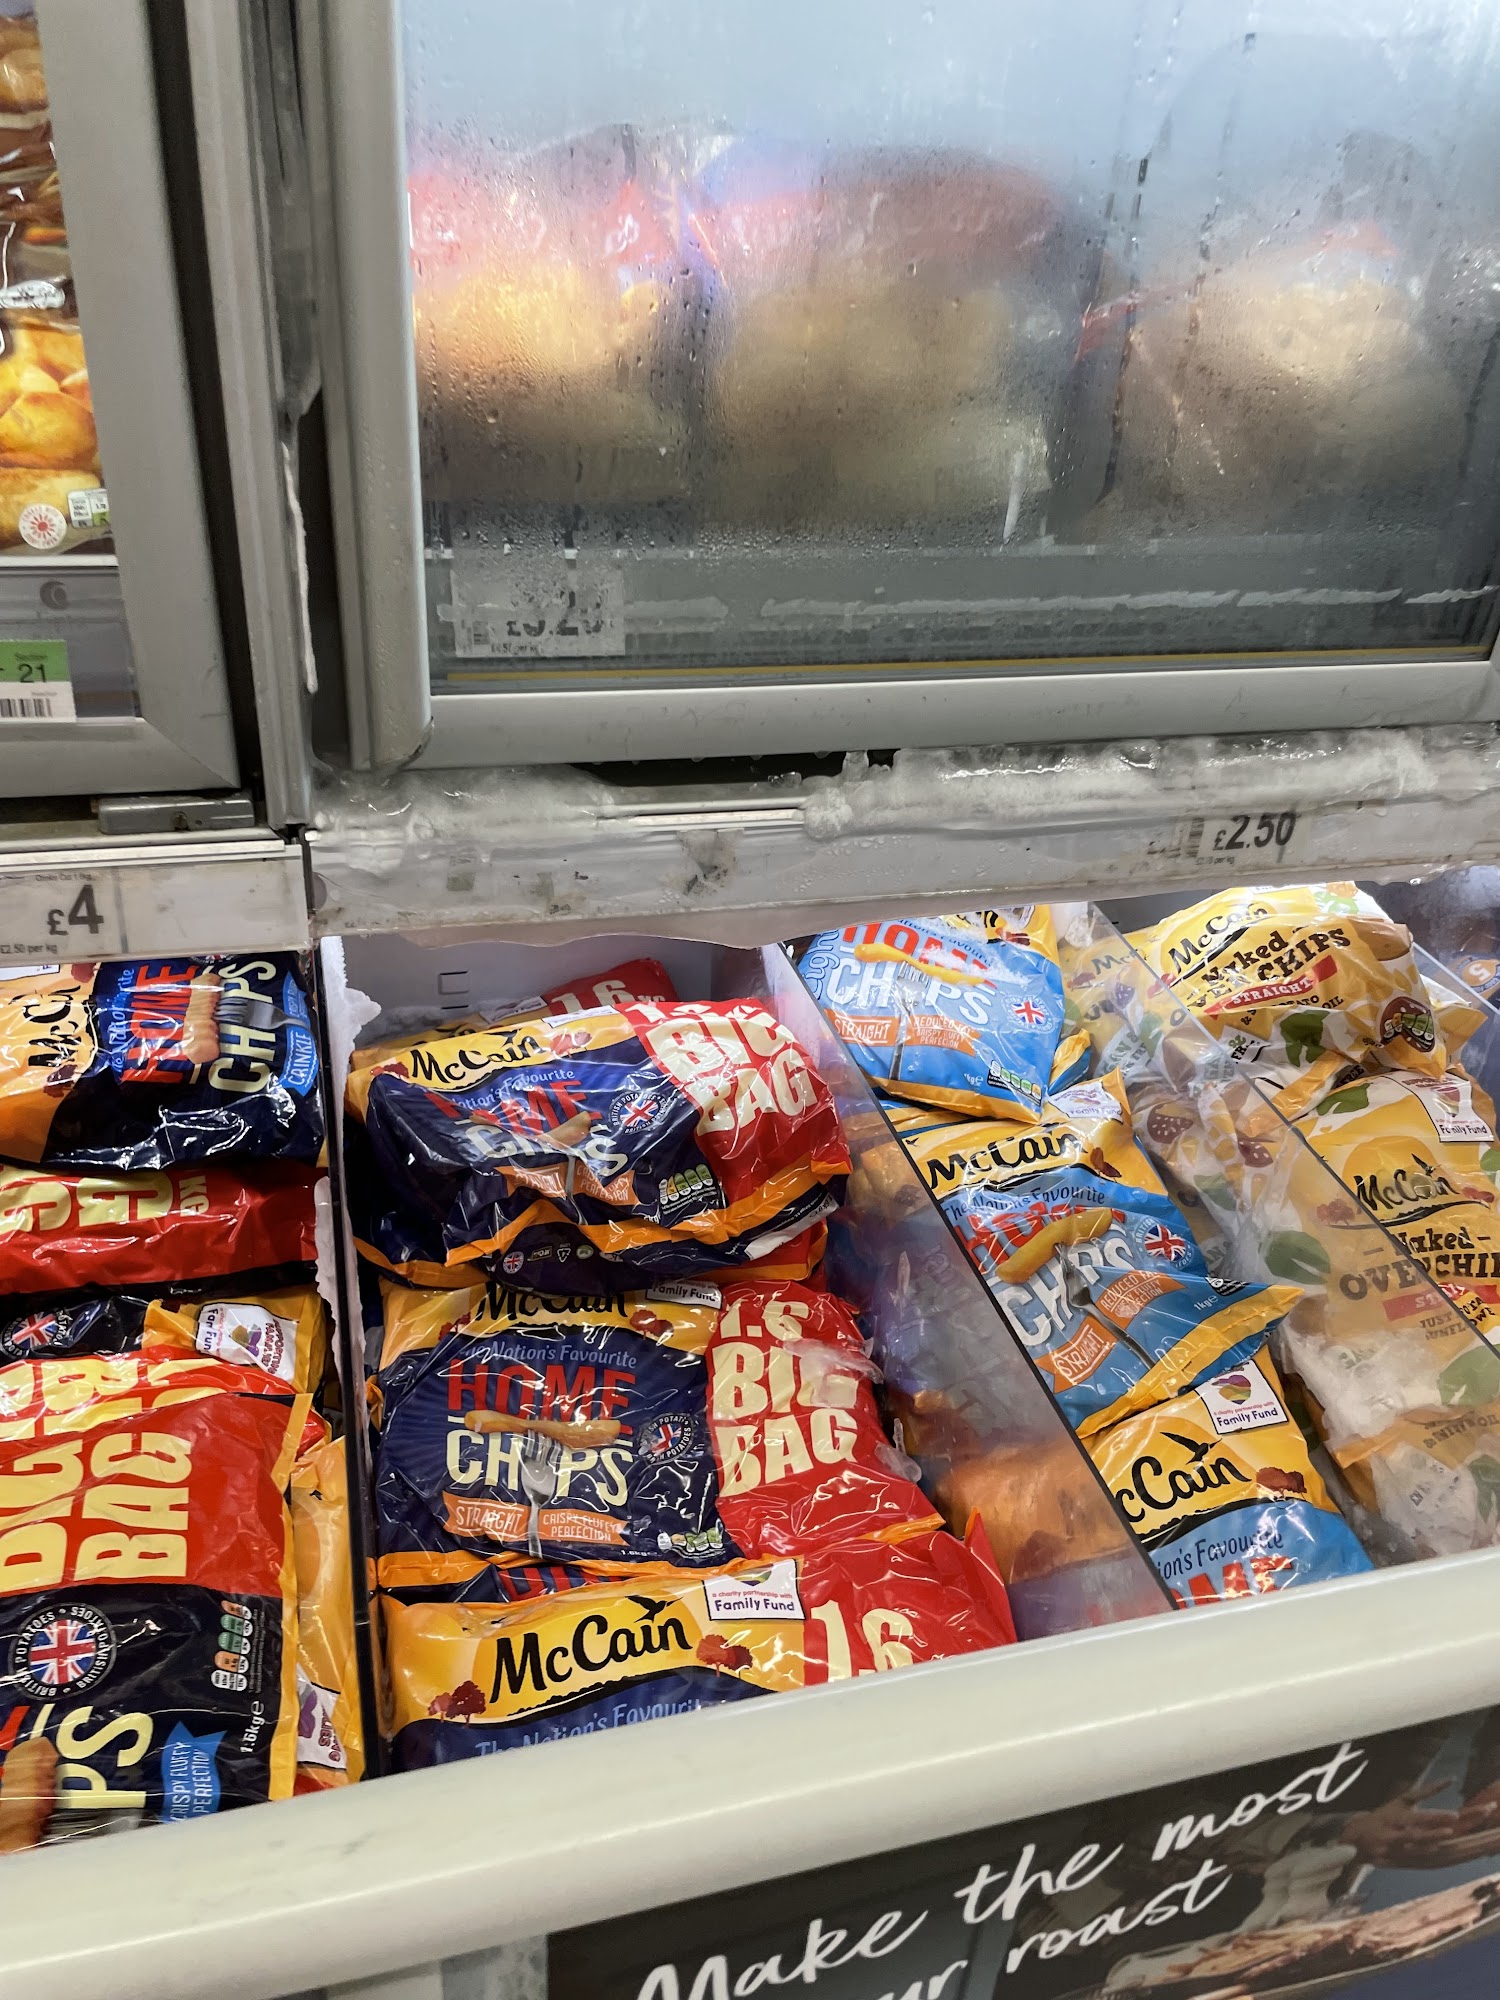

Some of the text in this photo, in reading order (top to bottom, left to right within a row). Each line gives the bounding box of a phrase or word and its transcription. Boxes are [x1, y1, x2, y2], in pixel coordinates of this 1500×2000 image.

[18, 664, 46, 683] 21
[1213, 811, 1297, 851] £2.50
[46, 884, 104, 935] £4
[1257, 927, 1351, 982] CHIPS
[1231, 976, 1313, 1004] STRAIGHT
[834, 1019, 891, 1041] STRAIGHT
[288, 1031, 312, 1086] CRINKLE
[411, 1034, 546, 1084] McCain
[685, 1048, 818, 1137] BAG
[1031, 1186, 1105, 1205] Favourite
[1100, 1274, 1139, 1312] REDUCED
[489, 1341, 557, 1362] Nation's
[559, 1344, 637, 1369] Favourite
[447, 1357, 637, 1435] HOME
[1216, 1407, 1279, 1427] Family Fund
[666, 1427, 692, 1458] POTATOES
[714, 1407, 860, 1497] BAG
[73, 1432, 193, 1581] BAG
[1114, 1455, 1252, 1523] cCain
[455, 1506, 523, 1532] STRAIGHT
[543, 1513, 580, 1527] CRISPY
[714, 1597, 795, 1612] Family Fund
[718, 1590, 742, 1599] charity
[743, 1590, 779, 1600] partnership
[15, 1611, 56, 1664] POTATOES
[70, 1606, 111, 1689] BRITISH POTATOES
[489, 1614, 693, 1704] McCain
[169, 1741, 192, 1777] FLUFFY
[638, 1741, 1369, 2000] Make the most
[1005, 1858, 1231, 1974] roast
